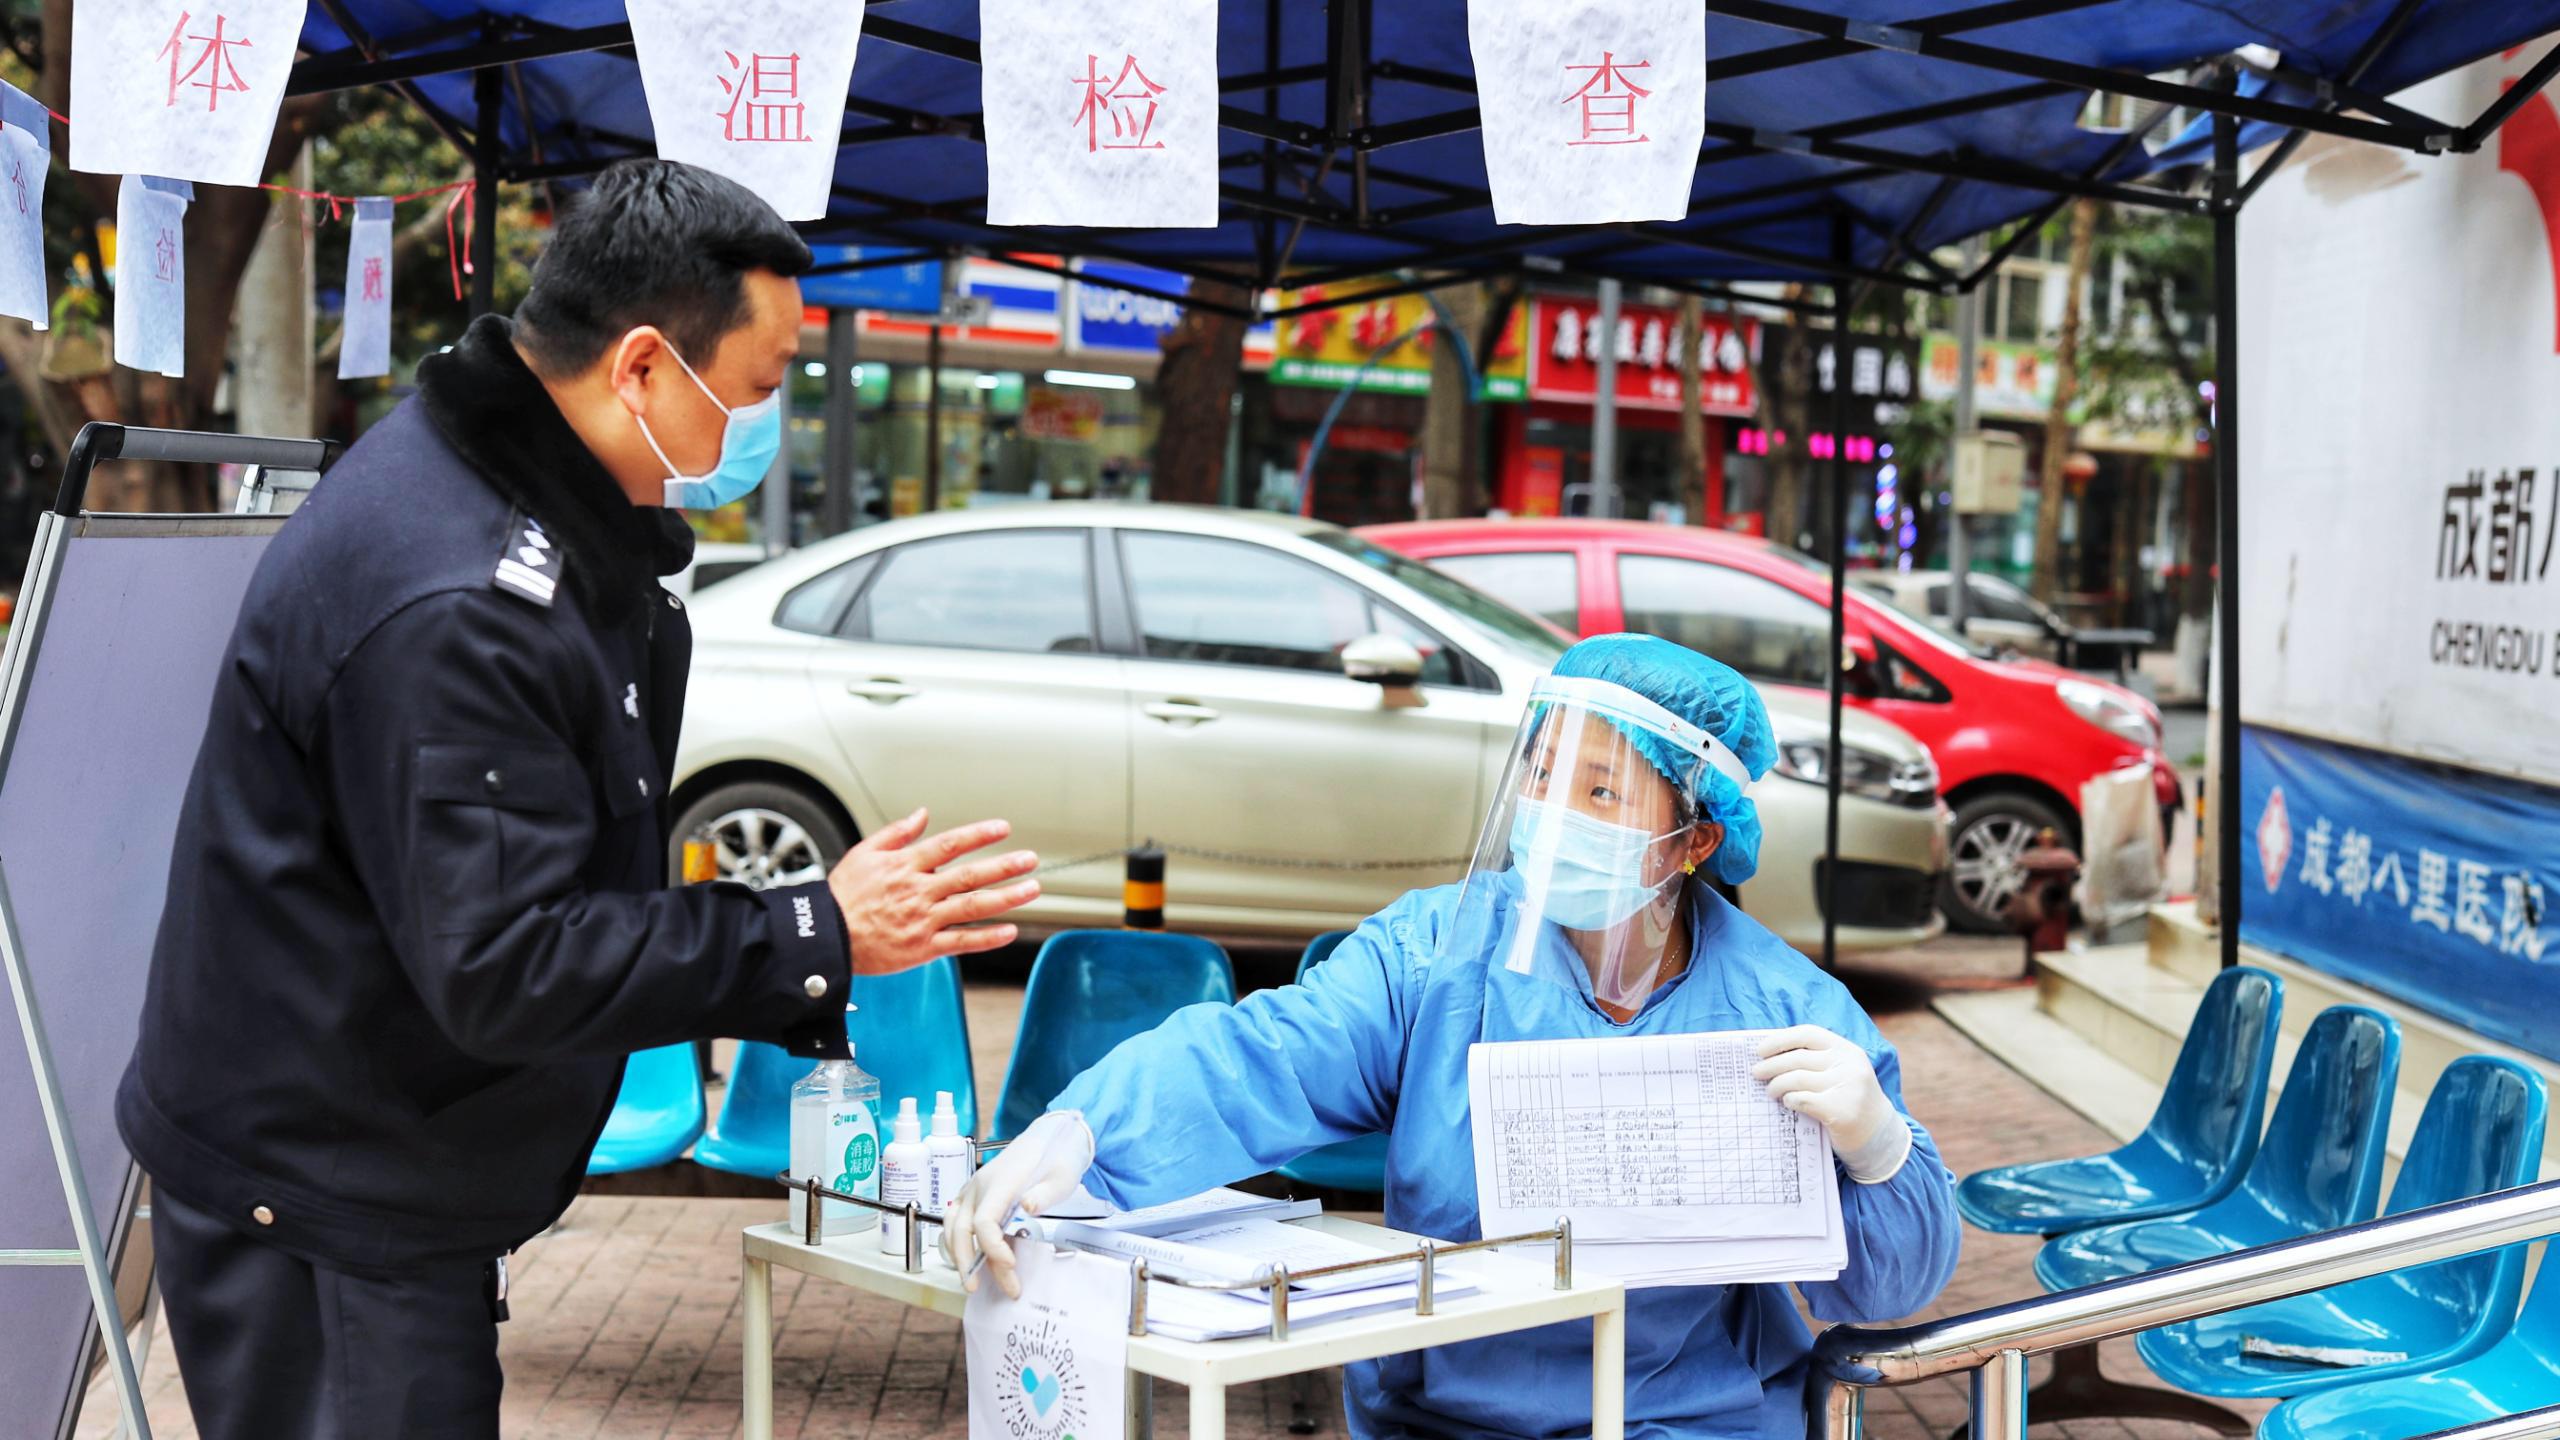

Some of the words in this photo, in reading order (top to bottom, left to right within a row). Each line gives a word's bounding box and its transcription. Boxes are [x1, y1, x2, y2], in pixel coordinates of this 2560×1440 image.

[156, 10, 252, 112] 体
[716, 50, 813, 143] 温
[1072, 53, 1167, 154] 检
[1562, 51, 1652, 147] 查
[2430, 618, 2544, 676] CHENGDU
[791, 895, 816, 938] POLICE
[2299, 815, 2546, 963] 成都八里医院
[849, 1156, 873, 1174] 凝胶
[850, 1139, 873, 1157] 消毒
